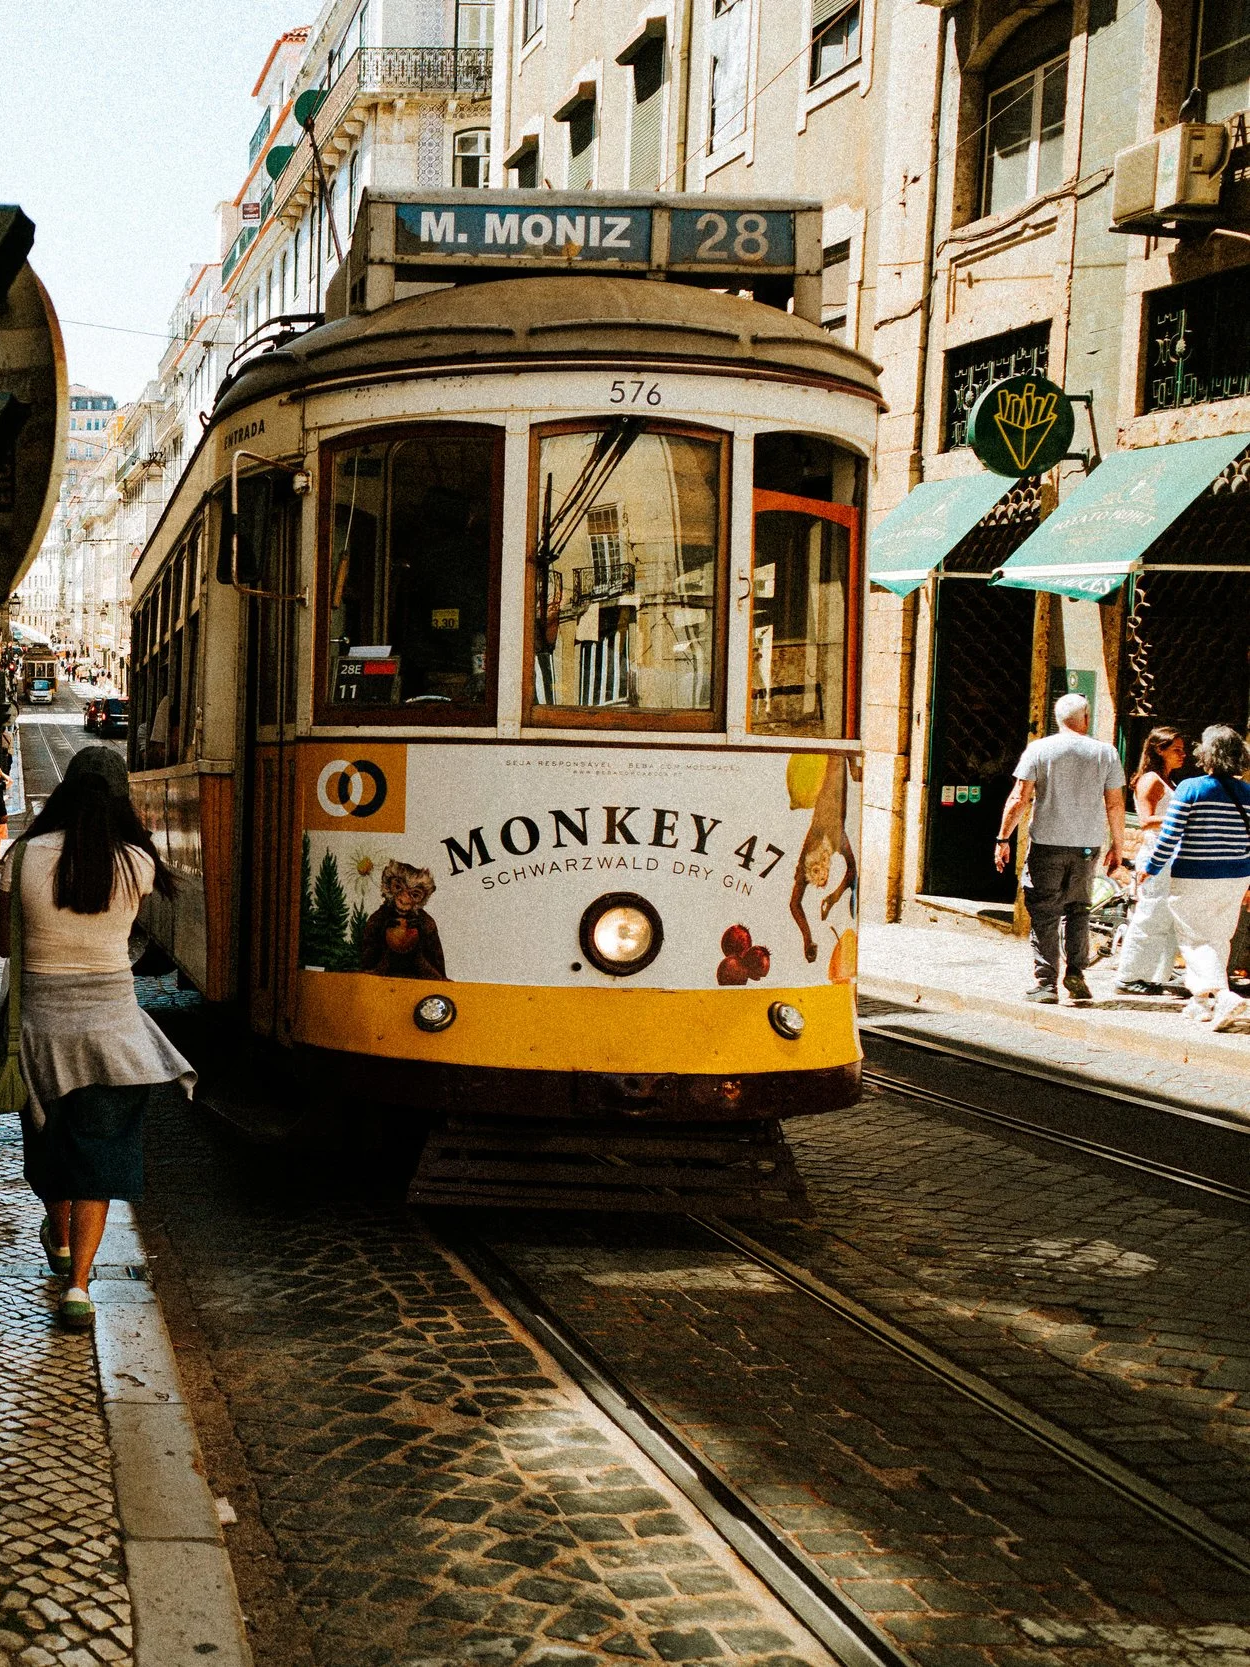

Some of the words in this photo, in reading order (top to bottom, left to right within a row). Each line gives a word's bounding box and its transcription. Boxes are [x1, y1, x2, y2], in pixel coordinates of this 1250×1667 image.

[419, 211, 468, 243] M.
[484, 213, 631, 249] MONIZ
[695, 212, 769, 261] 28
[608, 379, 662, 406] 576
[222, 418, 265, 451] ENTRADA
[340, 664, 362, 675] 28E
[339, 684, 358, 699] 11
[505, 759, 531, 767] SEJA
[440, 806, 722, 876] MONKEY
[734, 834, 785, 880] 47
[482, 857, 660, 890] SCHWARZWALD
[673, 860, 714, 881] DRY
[723, 874, 753, 896] GIN
